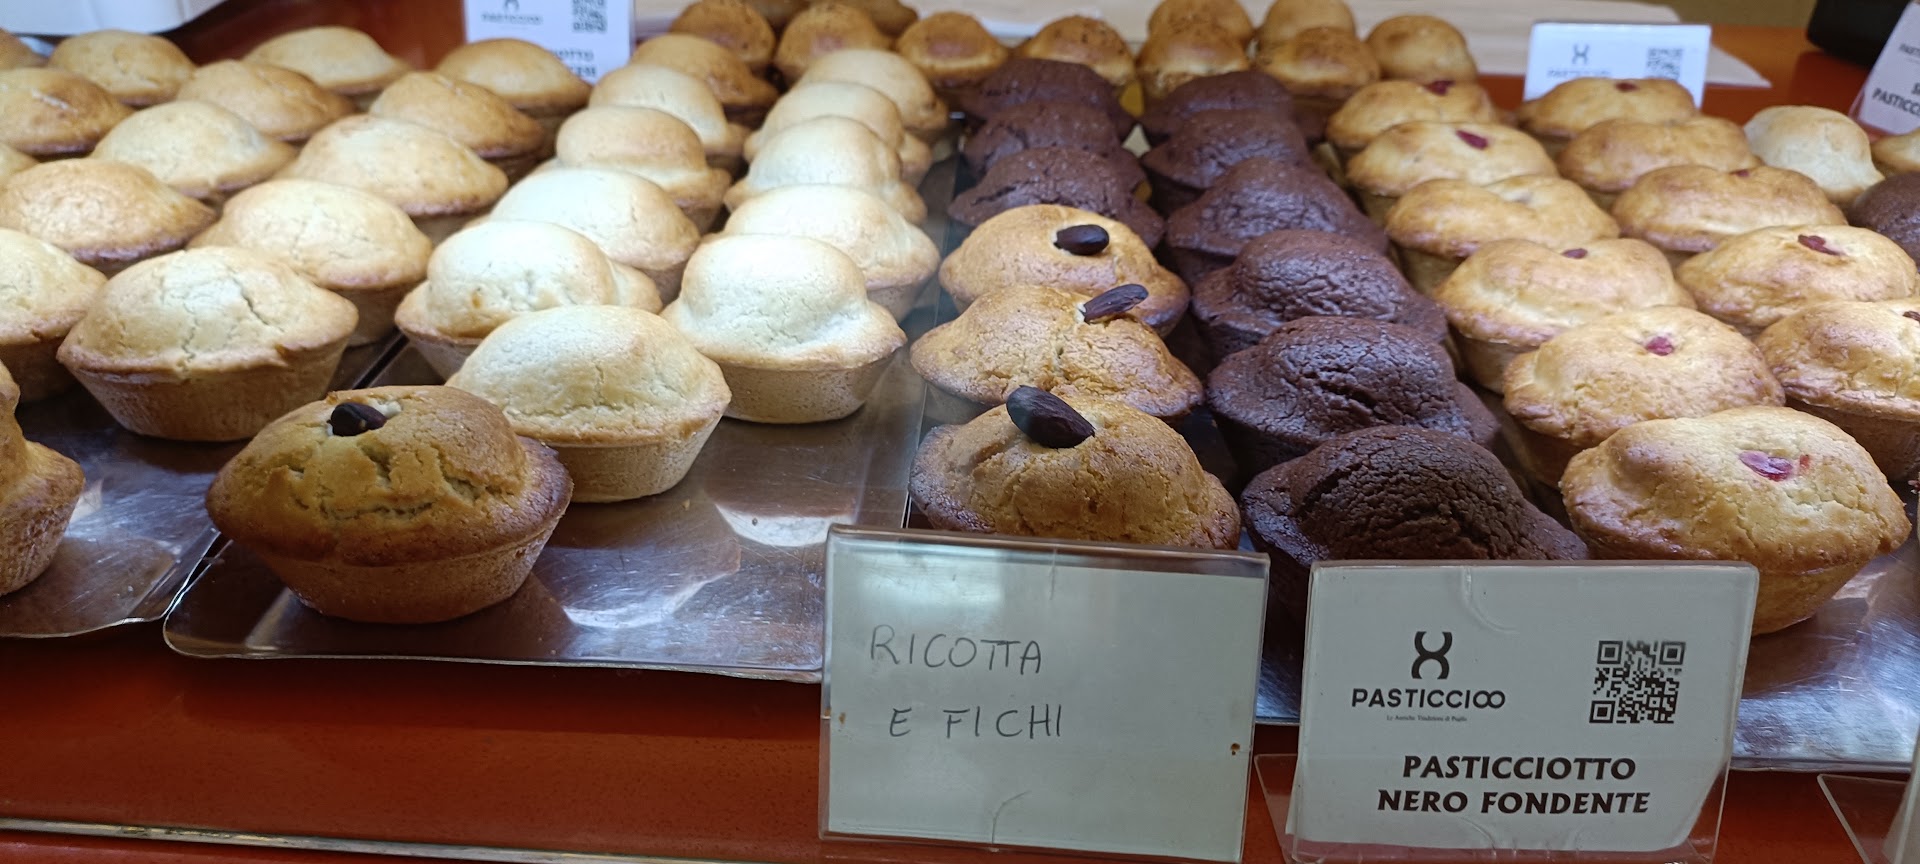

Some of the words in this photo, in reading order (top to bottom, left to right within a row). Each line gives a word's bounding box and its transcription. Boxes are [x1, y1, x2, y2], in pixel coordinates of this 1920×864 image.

[870, 624, 1042, 675] RICOTTA
[890, 708, 913, 738] E
[943, 704, 1063, 739] FICHI
[1403, 755, 1637, 780] PASTICCIOTTO
[1377, 789, 1469, 813] NERO
[1481, 792, 1650, 815] FONDENTE
